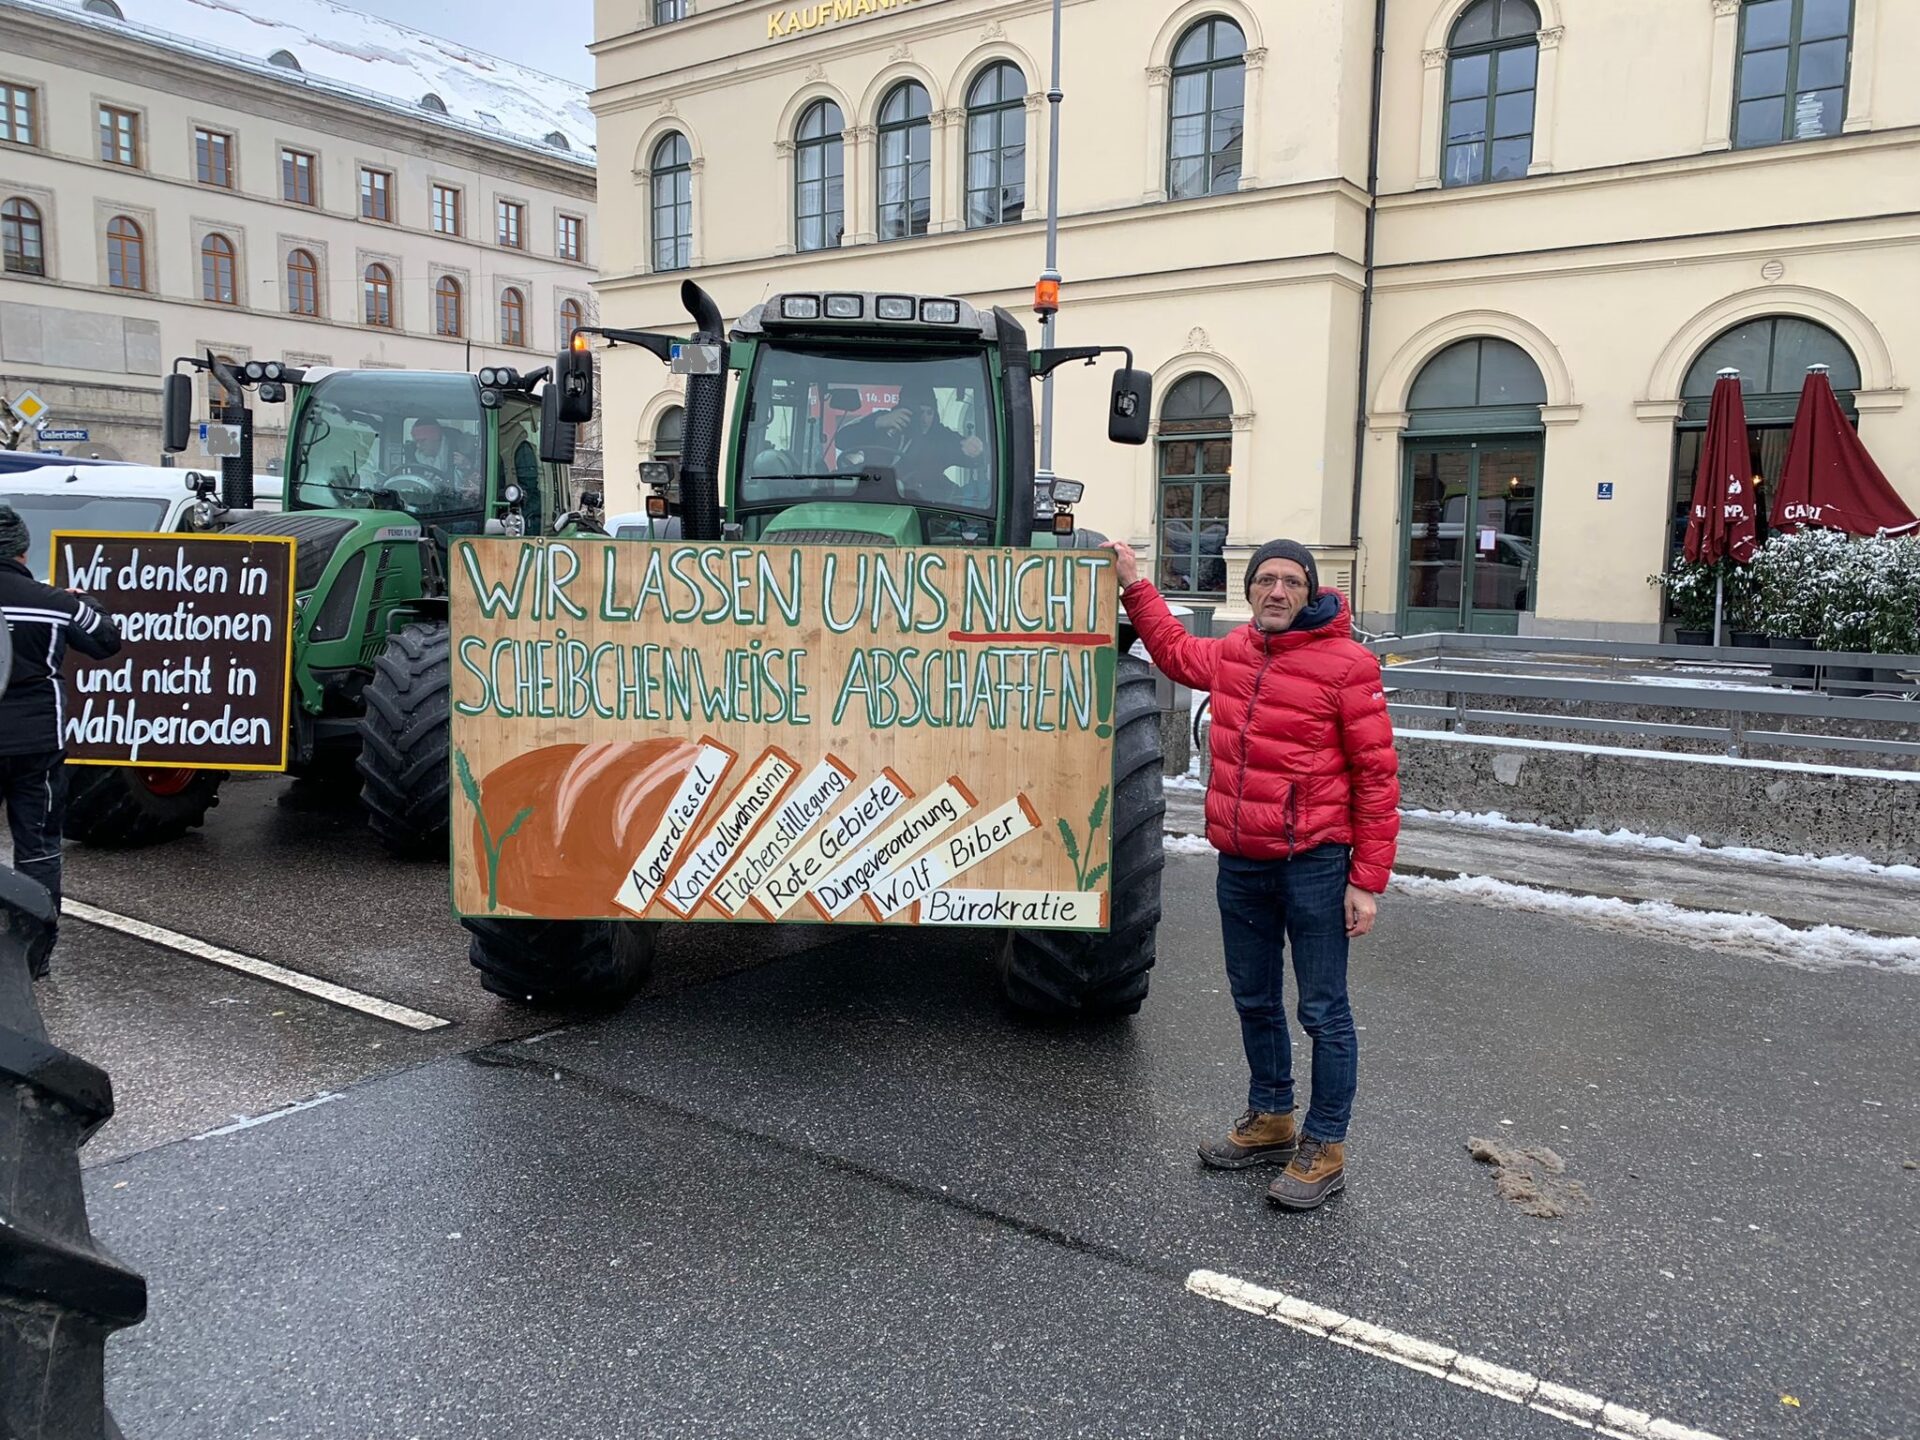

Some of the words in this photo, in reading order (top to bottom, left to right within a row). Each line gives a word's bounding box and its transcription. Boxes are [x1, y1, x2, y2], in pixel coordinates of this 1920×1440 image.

[40, 431, 86, 440] Galeriestr.
[1602, 483, 1609, 492] 7
[64, 544, 112, 592] Wir
[117, 546, 228, 594] denken
[239, 556, 268, 596] in
[459, 537, 587, 621] WIR
[600, 547, 801, 626] LASSEN
[821, 550, 948, 634] UNS
[960, 547, 1111, 633] NICHT
[111, 601, 272, 642] nerationen
[76, 658, 133, 694] und
[142, 656, 212, 695] nicht
[228, 658, 257, 696] in
[454, 629, 811, 726] SCHEIBCHENWEISE
[832, 645, 1116, 739] ABSCHAFFEN!
[65, 698, 271, 762] Wahlperioden
[631, 765, 716, 904] Agrardiesel
[667, 760, 789, 909] Kontrollwahnsinn
[714, 771, 846, 911] Flächenstilllegung
[765, 857, 822, 908] Rote
[819, 783, 899, 859] Gebiete
[818, 797, 957, 910] Düngeverordnung
[874, 858, 931, 912] Wolf
[950, 816, 1014, 868] Biber
[929, 890, 1077, 922] Bürokratie
